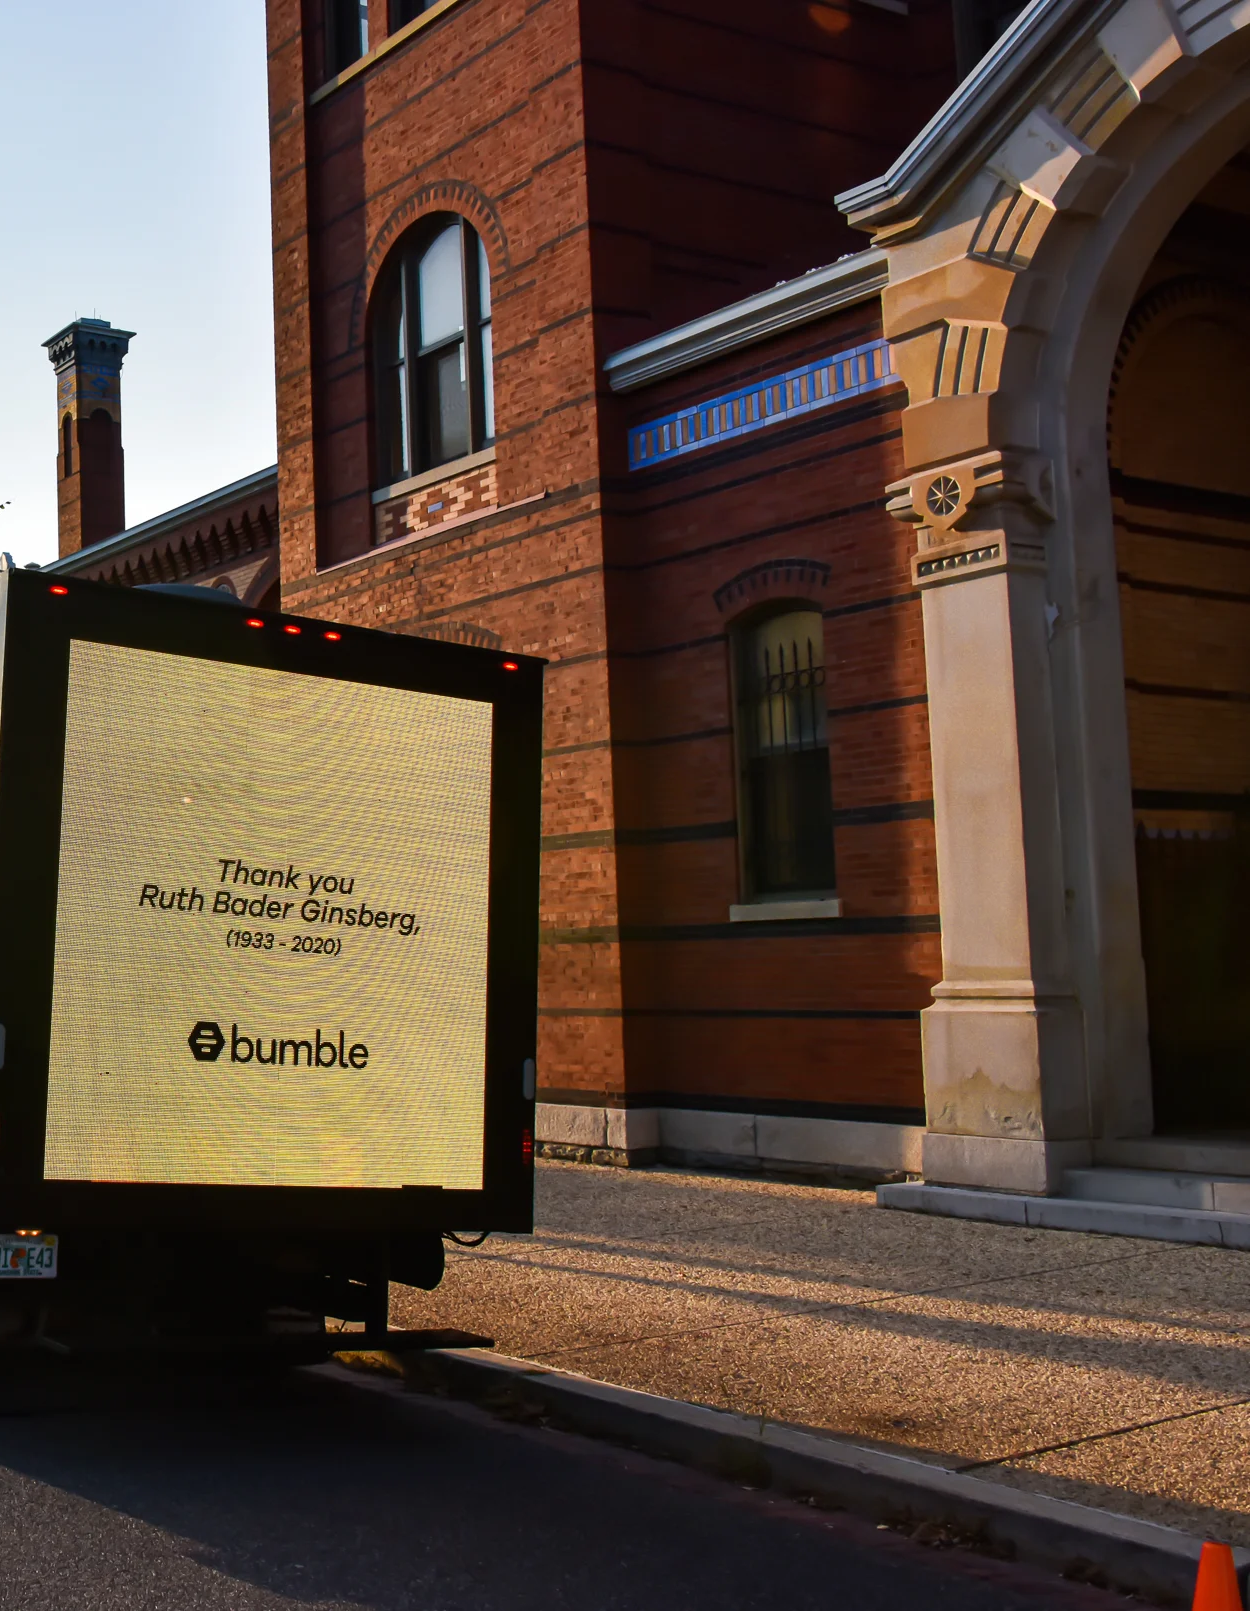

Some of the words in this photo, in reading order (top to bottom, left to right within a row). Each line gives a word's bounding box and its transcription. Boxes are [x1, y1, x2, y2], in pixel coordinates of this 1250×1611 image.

[219, 858, 301, 890] Thank
[308, 874, 355, 896] you
[139, 883, 204, 913] Ruth
[212, 890, 294, 919] Bader
[300, 899, 421, 937] Ginsberg,
[226, 929, 275, 950] (1933
[290, 935, 343, 957] 2020)
[230, 1023, 369, 1069] bumble
